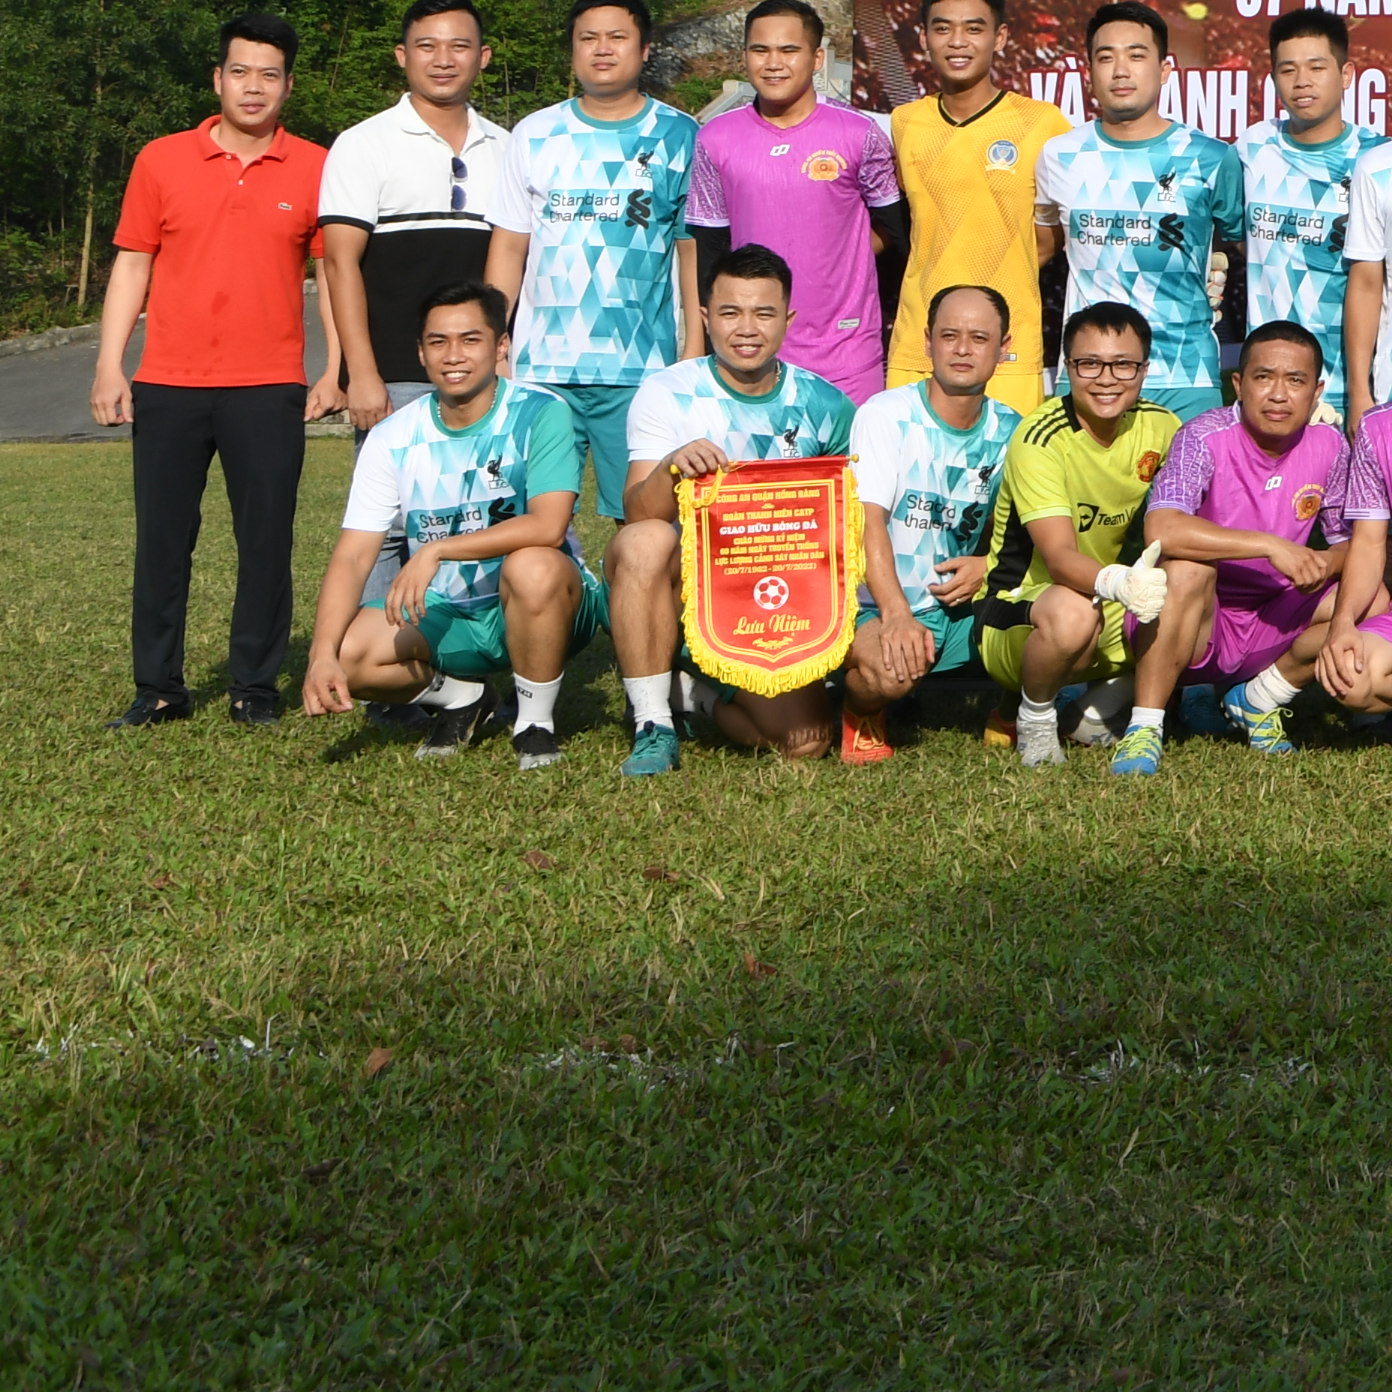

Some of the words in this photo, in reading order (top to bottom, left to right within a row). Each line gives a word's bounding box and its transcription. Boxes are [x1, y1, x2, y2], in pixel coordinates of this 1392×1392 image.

[1030, 57, 1089, 129] VÀ
[550, 192, 620, 209] Standard
[549, 208, 619, 224] Chartered
[1079, 213, 1151, 230] Standard
[1253, 208, 1325, 229] Standard
[1077, 230, 1151, 247] Chartered
[1250, 224, 1323, 247] Chartered
[720, 525, 745, 535] GIAO
[747, 522, 771, 533] HỮU
[772, 520, 801, 532] BÓNG
[802, 519, 818, 530] ĐÁ
[733, 615, 765, 635] Lưu
[768, 614, 811, 637] Niệm
